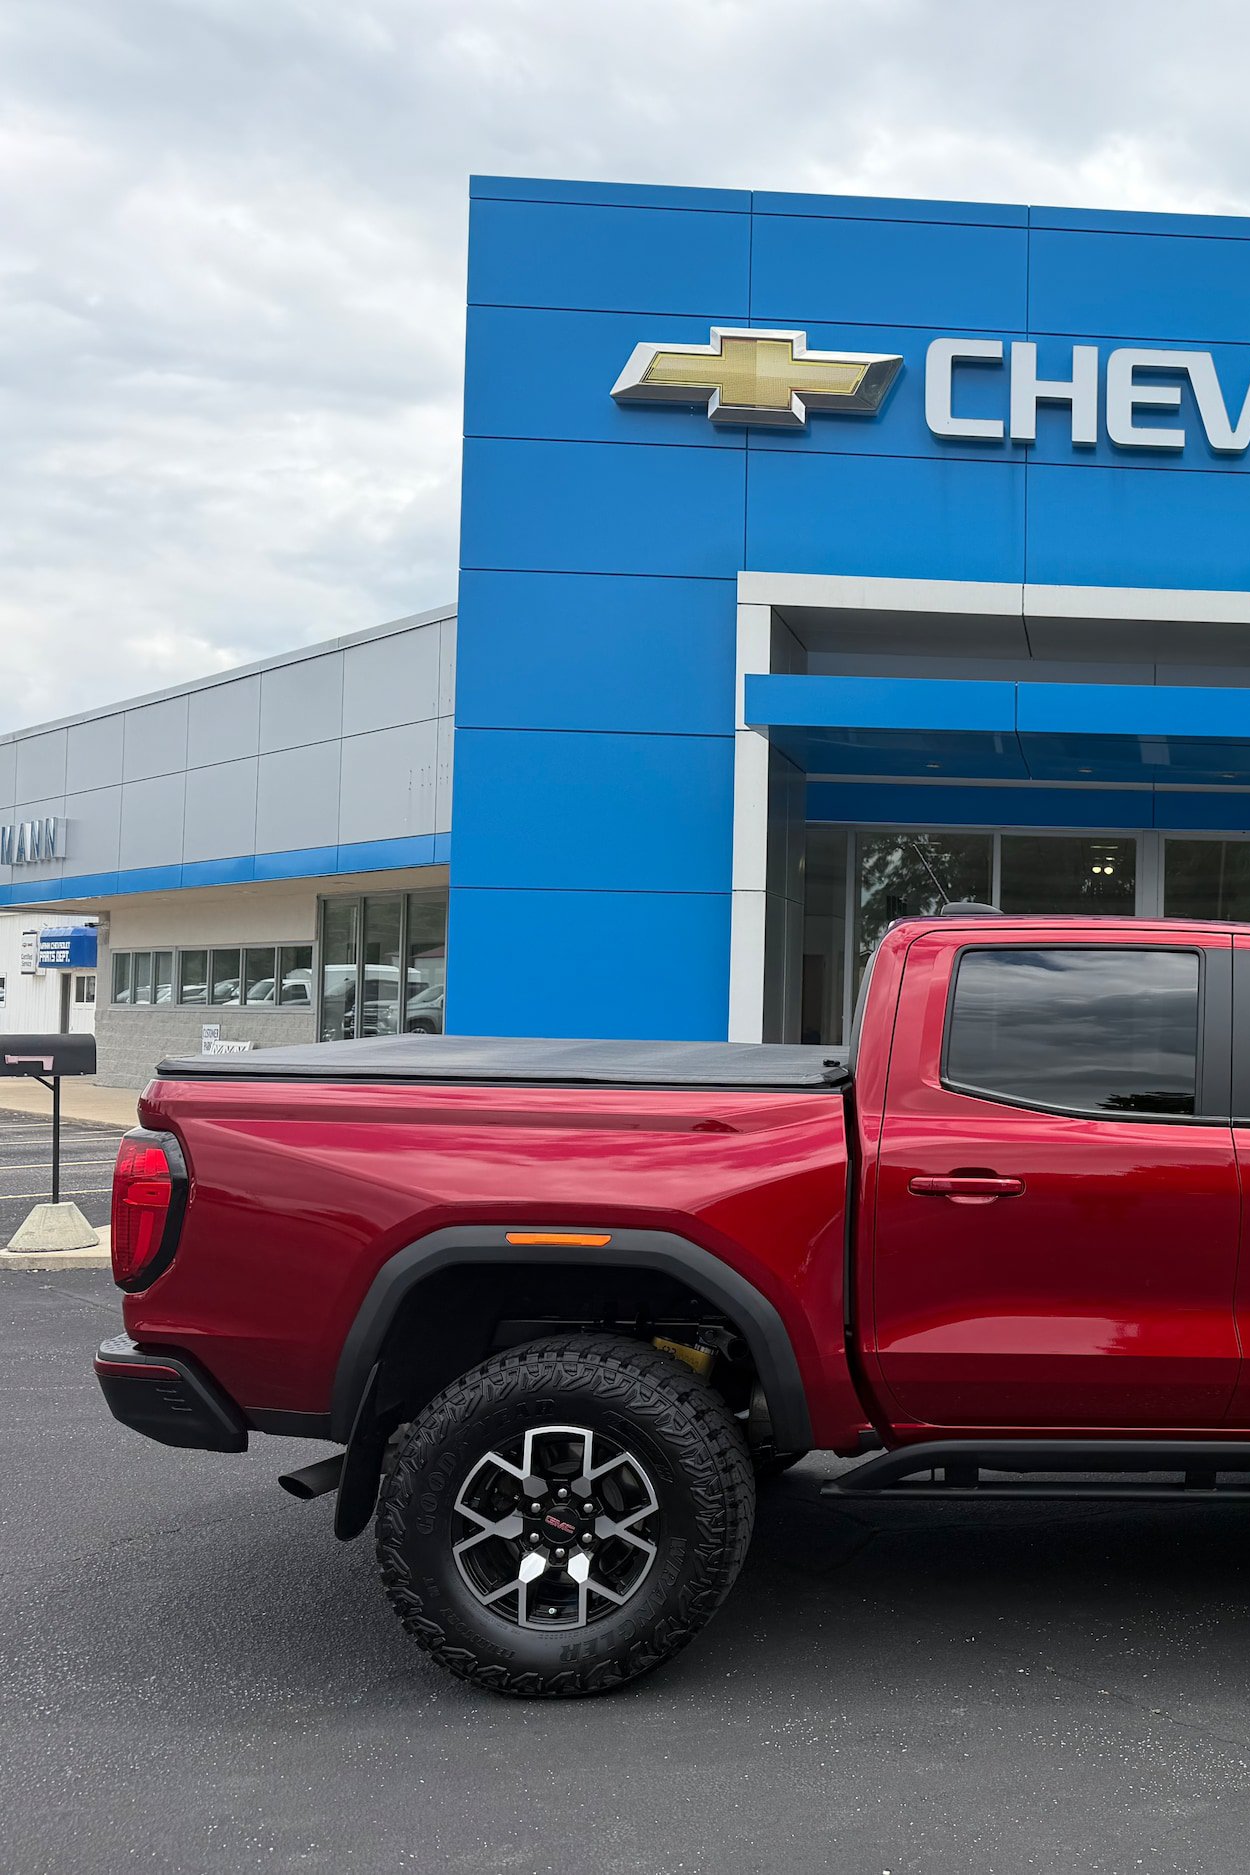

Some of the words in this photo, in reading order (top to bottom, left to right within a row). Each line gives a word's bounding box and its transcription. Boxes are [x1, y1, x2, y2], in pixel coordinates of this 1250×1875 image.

[40, 950, 55, 962] PARTS
[544, 1514, 576, 1534] GMC
[559, 1536, 688, 1664] WRANGLER
